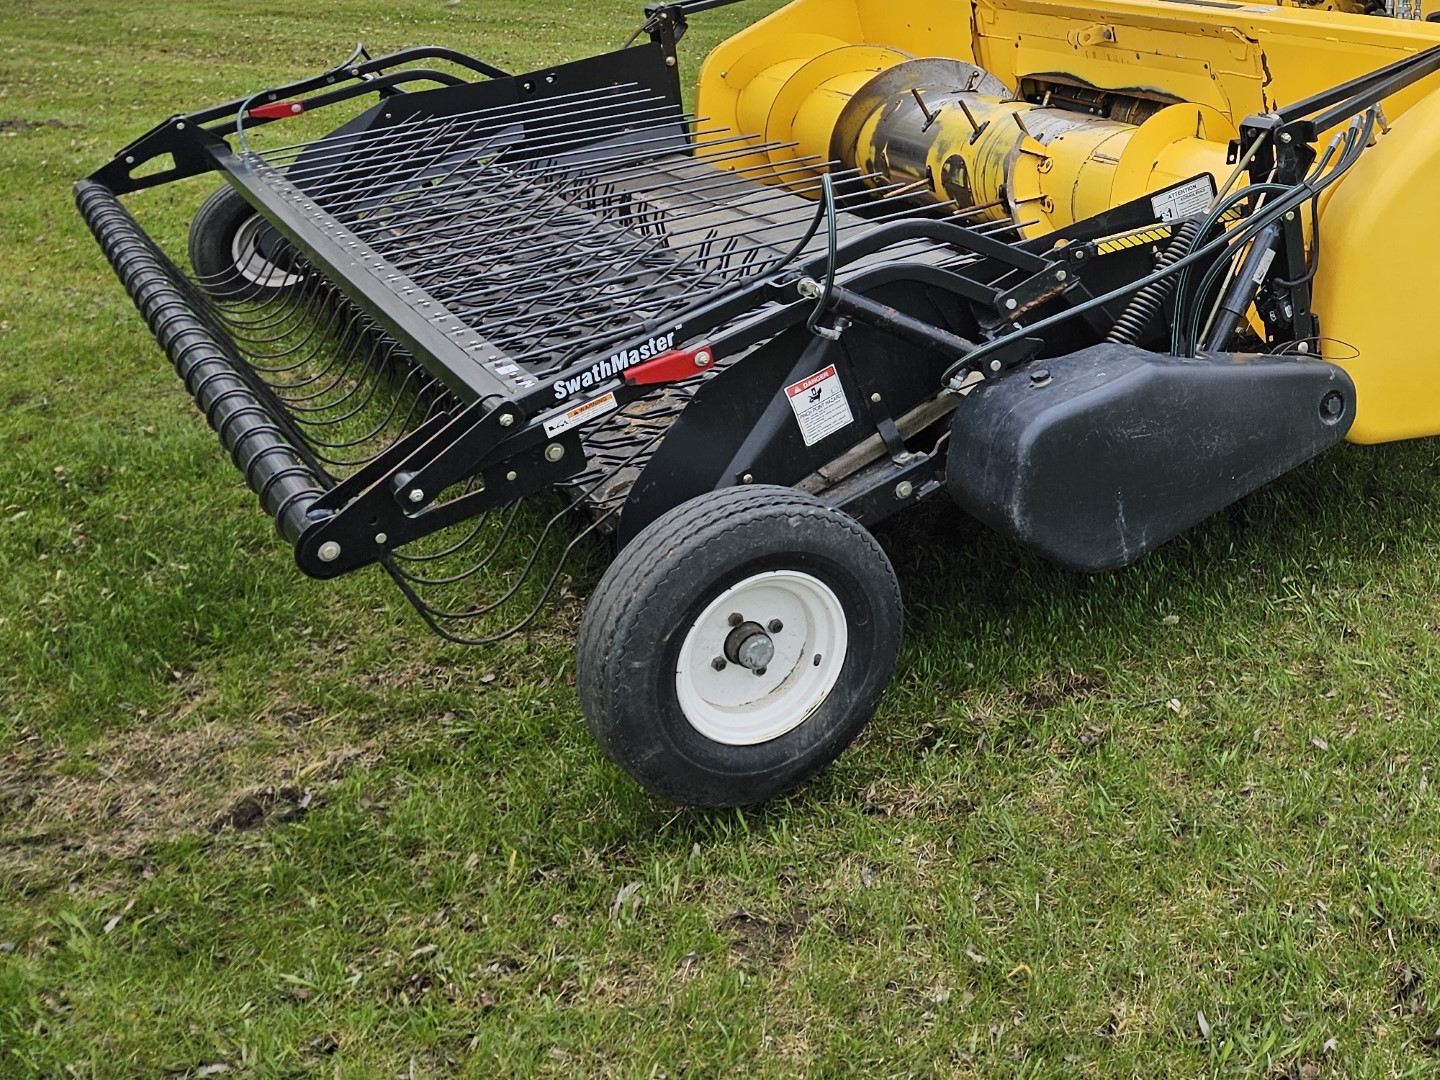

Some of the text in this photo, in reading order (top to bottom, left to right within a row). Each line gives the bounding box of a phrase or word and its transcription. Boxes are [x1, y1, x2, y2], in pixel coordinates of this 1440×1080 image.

[1168, 184, 1198, 200] ATTENTION
[802, 371, 829, 388] DANGER
[578, 395, 608, 413] WARNING
